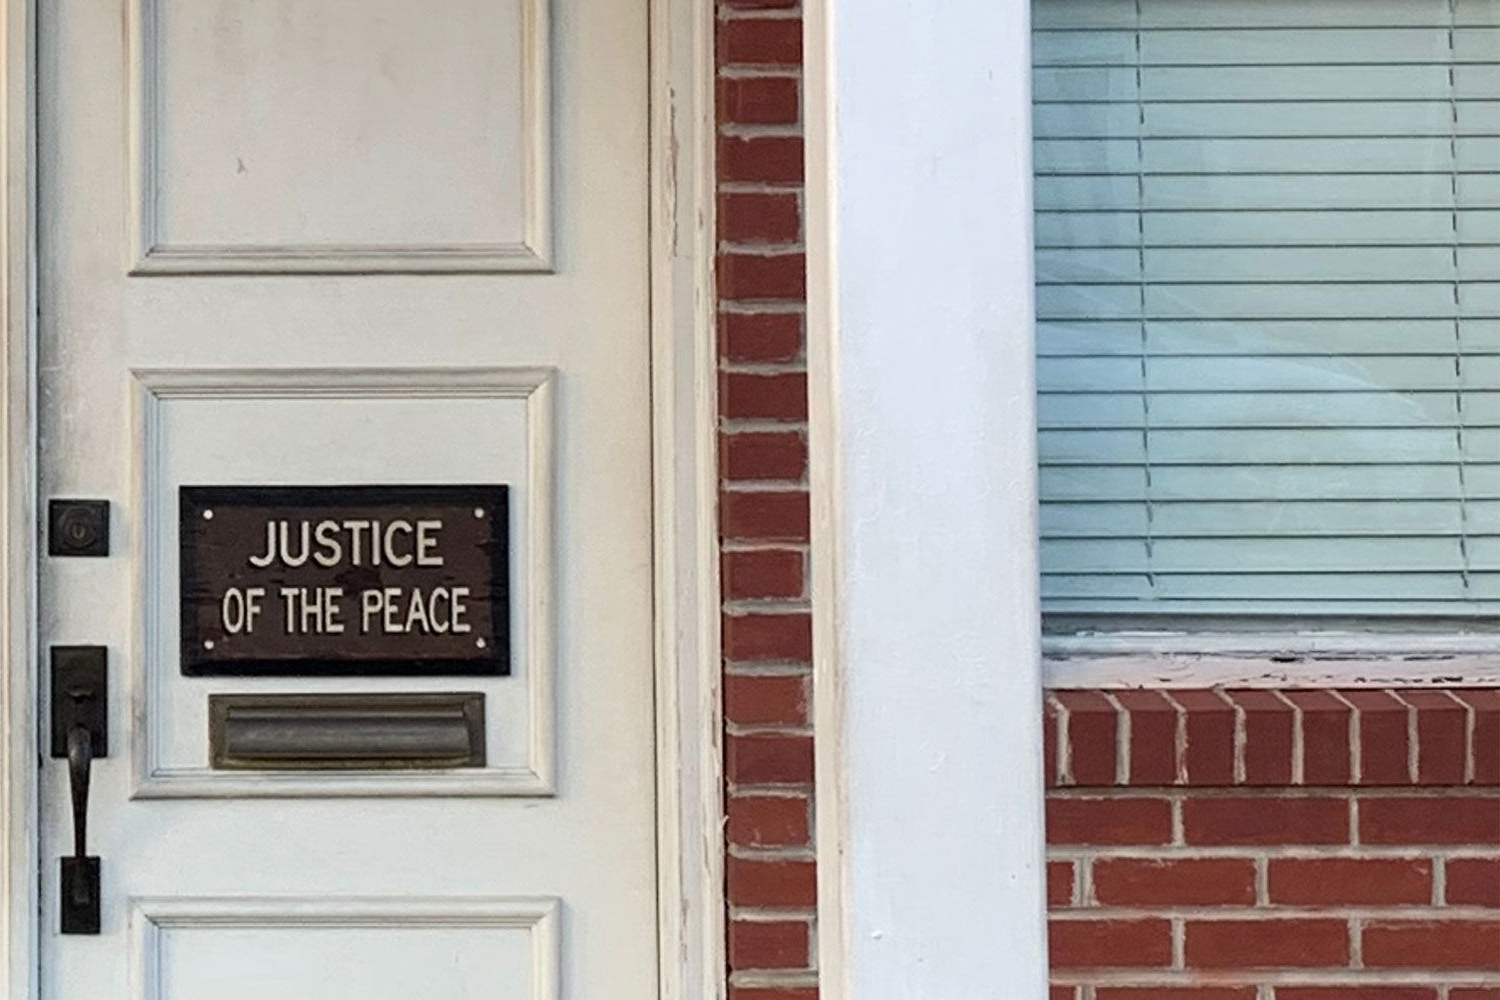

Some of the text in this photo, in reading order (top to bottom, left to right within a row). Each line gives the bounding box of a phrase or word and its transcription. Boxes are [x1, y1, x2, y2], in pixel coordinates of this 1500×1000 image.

[250, 520, 444, 567] JUSTICE
[223, 587, 472, 633] OF THE PEACE
